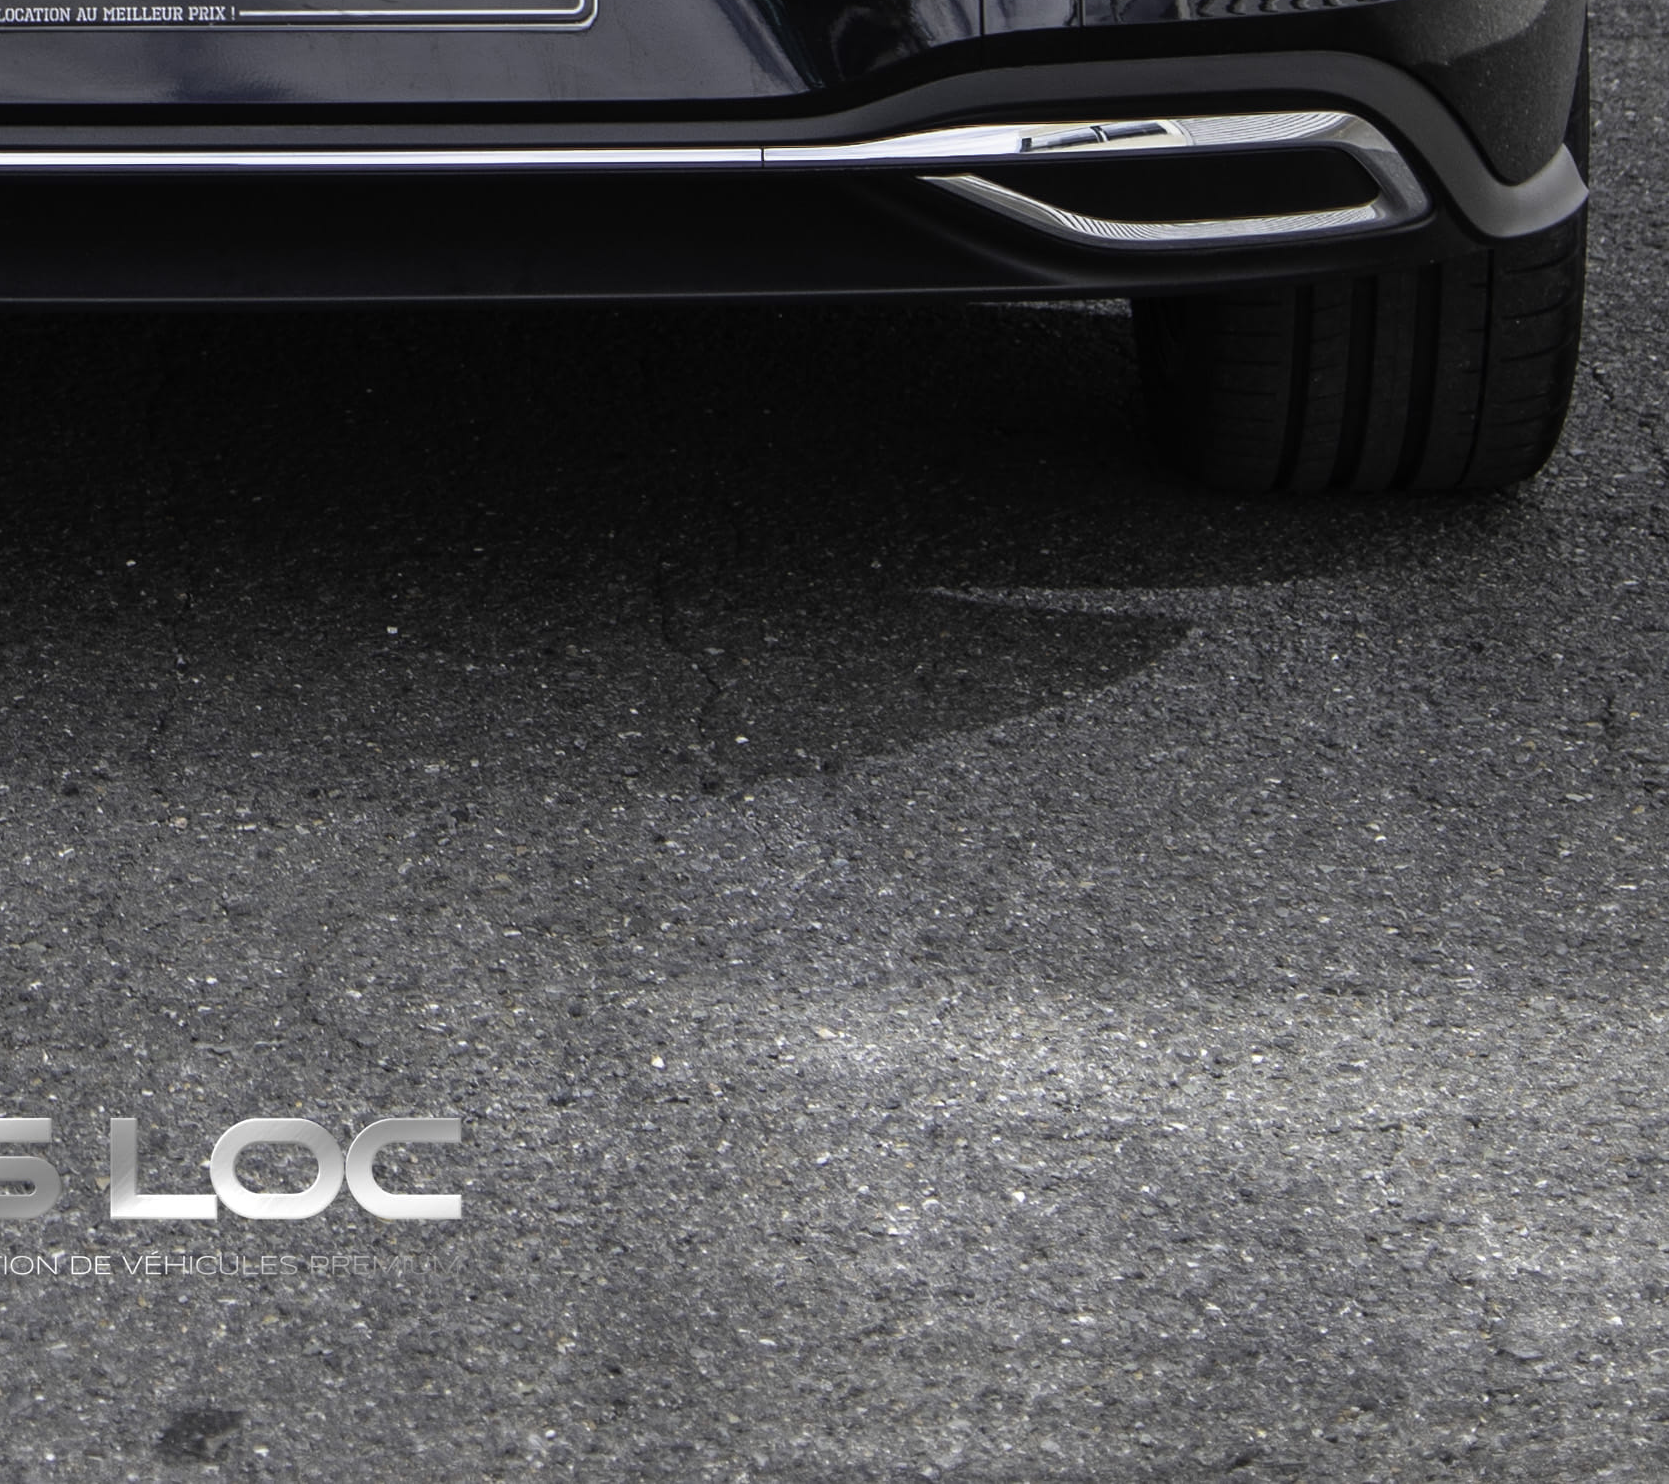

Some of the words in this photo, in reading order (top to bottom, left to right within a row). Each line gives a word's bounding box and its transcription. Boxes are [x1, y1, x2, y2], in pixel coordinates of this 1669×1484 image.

[75, 7, 98, 22] AU
[102, 6, 184, 22] MEILLEUR
[188, 5, 226, 21] PRIX
